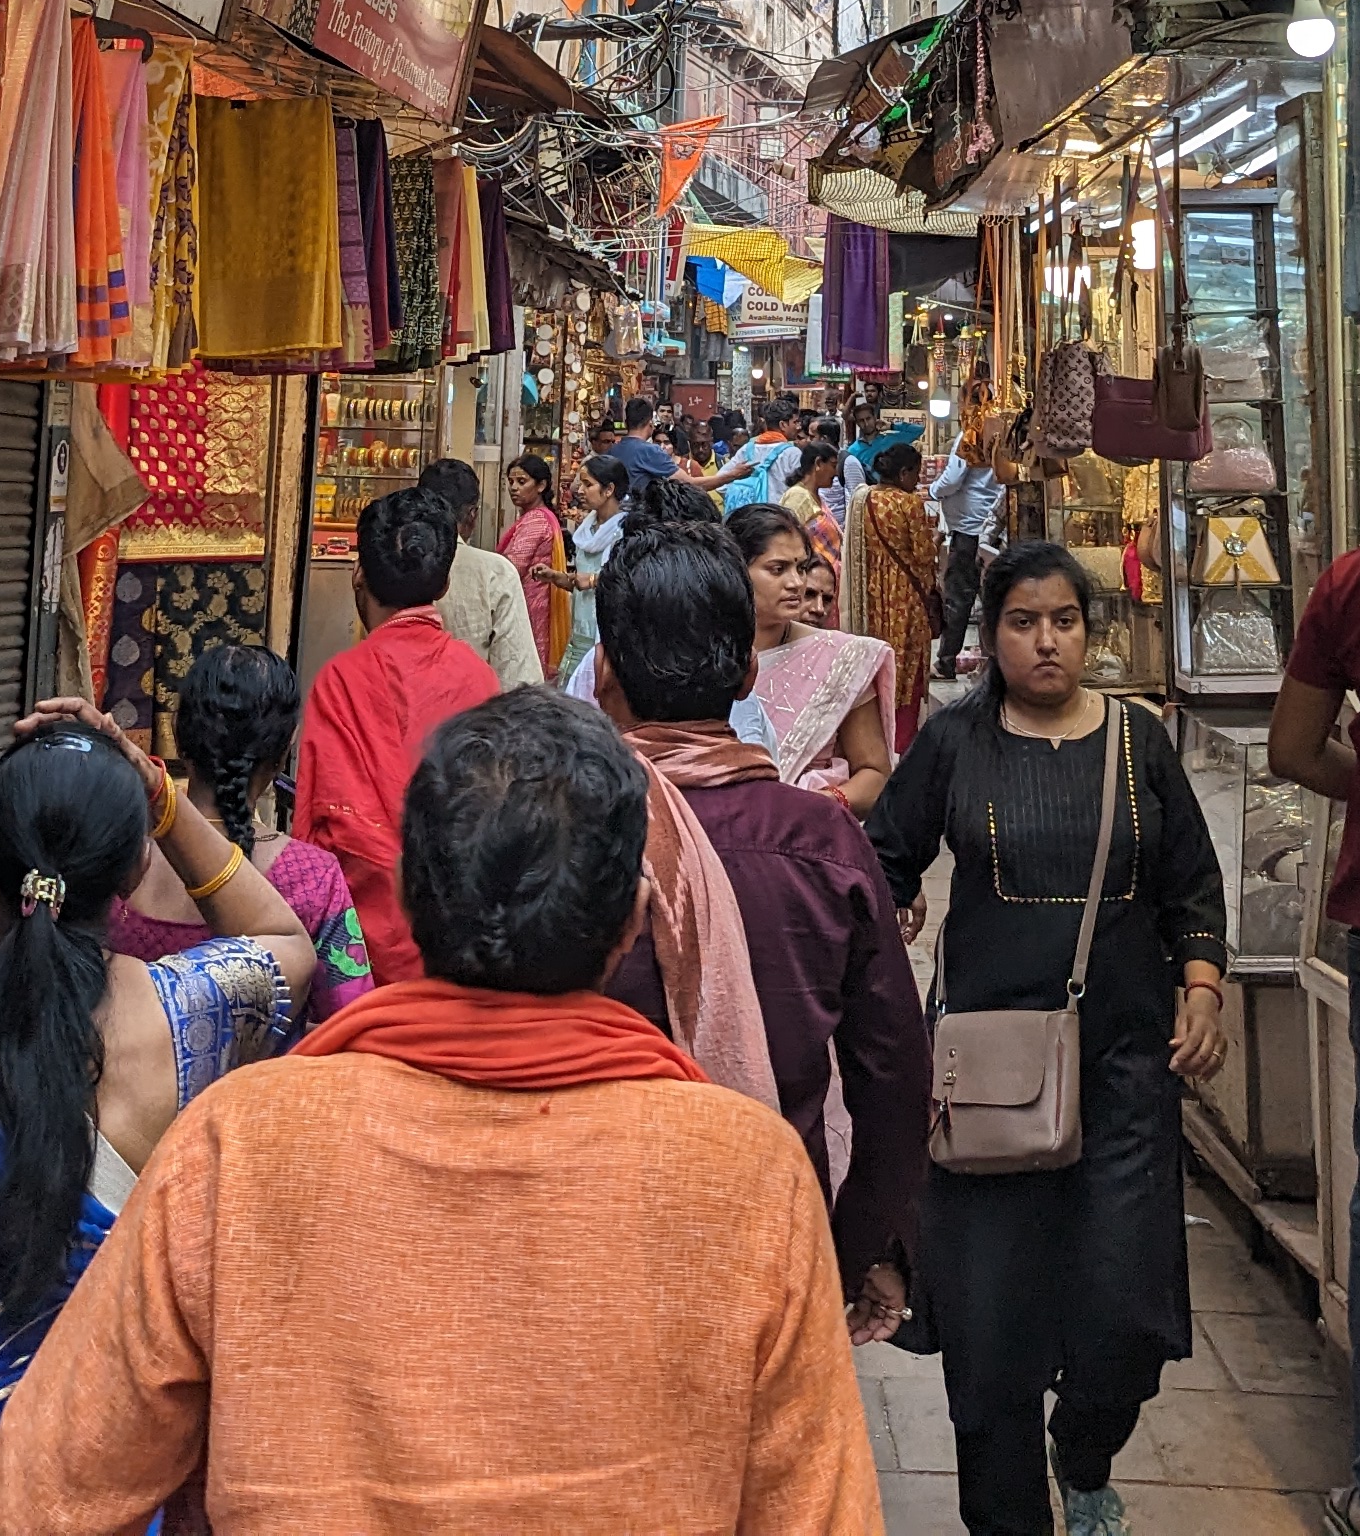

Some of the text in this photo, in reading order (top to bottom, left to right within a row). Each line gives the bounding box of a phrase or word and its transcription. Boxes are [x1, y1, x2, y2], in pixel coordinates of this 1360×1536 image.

[348, 11, 385, 72] Factory
[382, 37, 399, 77] of
[747, 286, 773, 297] COL
[747, 301, 810, 313] COLD WAT
[748, 314, 784, 323] Available
[785, 315, 804, 323] Here
